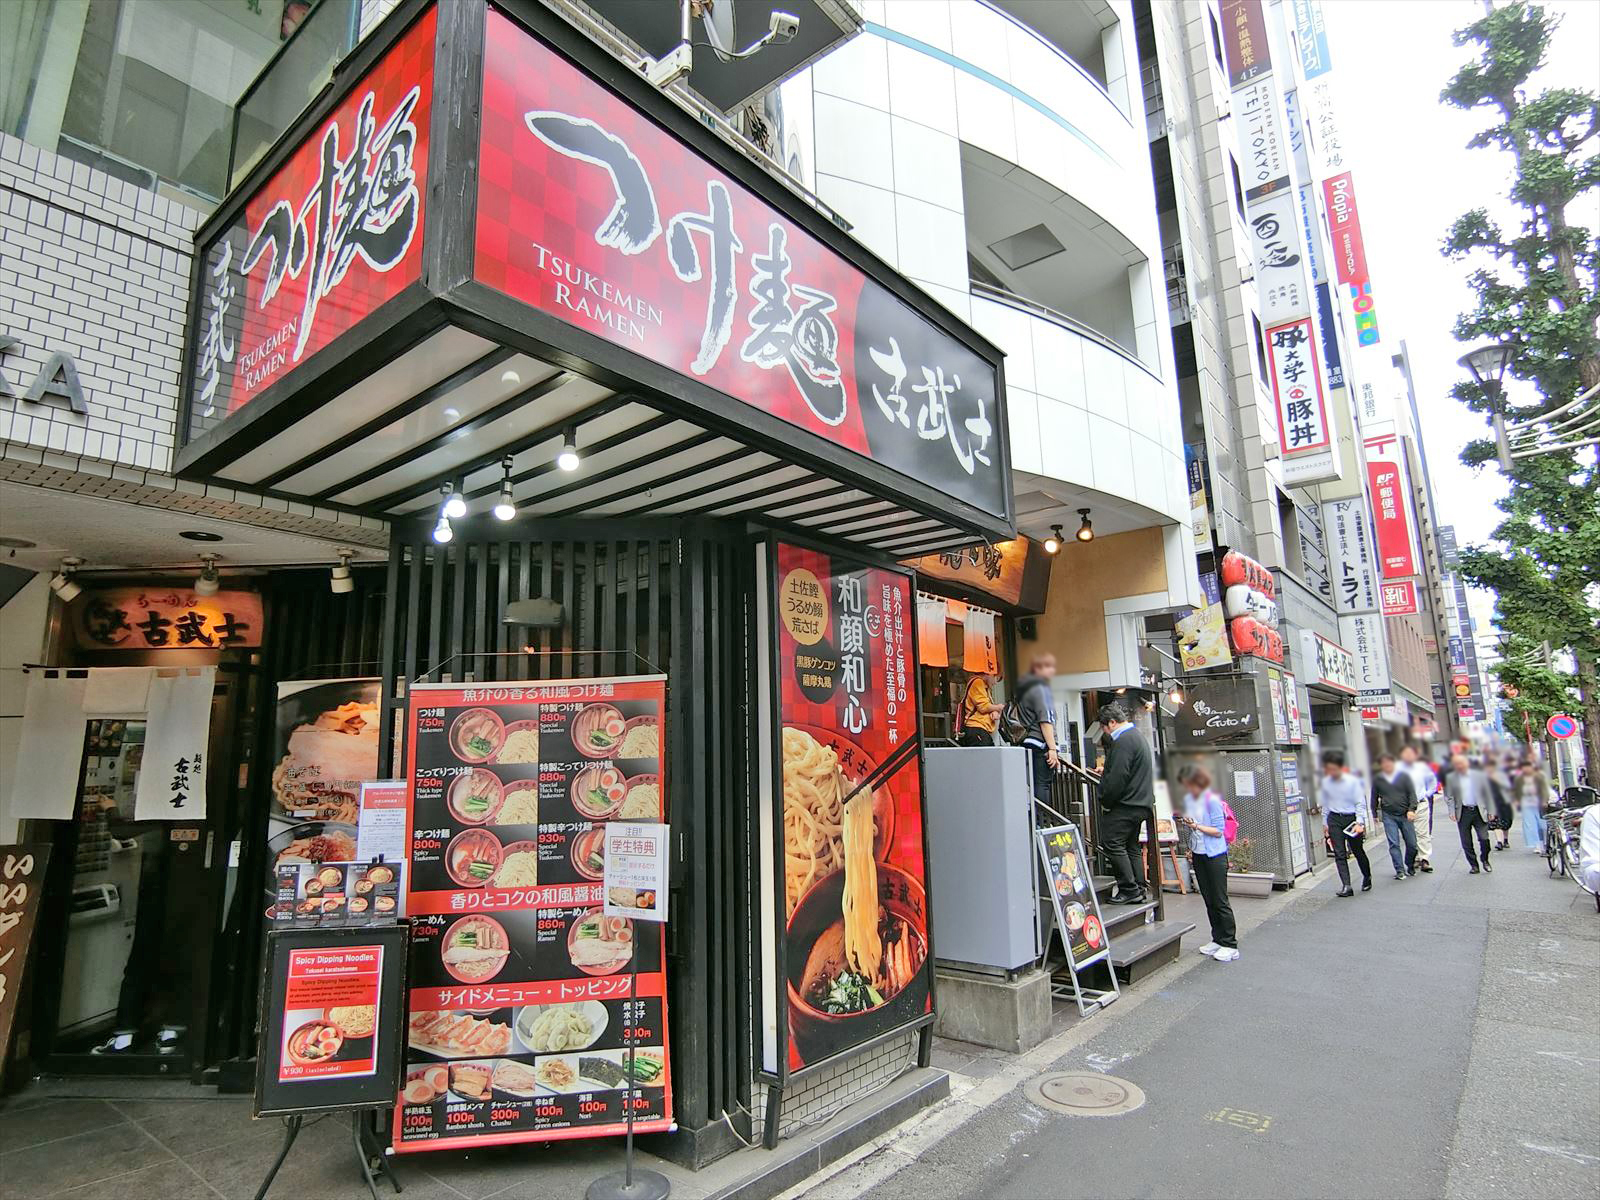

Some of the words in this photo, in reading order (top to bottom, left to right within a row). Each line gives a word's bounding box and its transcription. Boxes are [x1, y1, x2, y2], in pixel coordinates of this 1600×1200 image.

[1240, 66, 1258, 80] 4F
[1261, 86, 1272, 127] MODERN
[1268, 131, 1280, 170] KOREAN
[1250, 126, 1270, 181] TOKYO
[1260, 181, 1277, 193] 3F
[241, 86, 420, 363] つけ麺
[524, 110, 847, 426] つけ麺
[532, 242, 664, 328] TSUKEMEN
[554, 281, 646, 344] RAMEN
[239, 317, 298, 375] TSUKEMEN
[245, 348, 286, 392] RAMEN
[869, 336, 992, 475] 古武士
[1286, 398, 1317, 447] 豚丼
[1380, 487, 1396, 520] 郵便局
[1336, 514, 1348, 556] 司法書士法人
[790, 579, 819, 598] 土佐鰹
[1341, 561, 1358, 610] トライ
[1384, 586, 1406, 606] 靴
[787, 598, 822, 618] うるめ鰯
[136, 611, 250, 646] 古武士
[792, 617, 820, 635] 荒さば
[893, 586, 907, 703] 魚介出汁と豚骨の
[838, 574, 868, 734] 和顔和心
[796, 656, 836, 672] 黒豚ゲンコツ
[882, 584, 898, 744] 旨味を極めた至福の一杯
[463, 684, 614, 701] 魚介の香る和風つけ麺
[419, 708, 445, 718] つけ麺
[540, 703, 584, 712] 特製つけ麺
[419, 718, 444, 728] 750円
[540, 713, 566, 722] 880円
[416, 767, 473, 778] こってりつけ麺
[540, 760, 614, 772] 特製こってりつけ麺
[170, 757, 190, 808] 古武士
[416, 778, 443, 787] 750円
[540, 772, 566, 782] 880円
[414, 828, 450, 840] 辛つけ麺
[539, 822, 592, 834] 特製辛つけ麺
[414, 840, 441, 849] 800円
[539, 834, 566, 842] 930円
[612, 840, 654, 854] 学生特典
[450, 886, 604, 910] 香りとコクの和風醤油
[538, 906, 592, 919] 特製らーめん
[412, 915, 446, 926] らーめん
[538, 920, 566, 928] 860円
[412, 926, 439, 936] 730円
[296, 956, 315, 965] Spicy
[318, 955, 344, 964] Dipping
[346, 954, 375, 962] Noodles.
[438, 976, 632, 1006] サイドメニュー・トッピング
[578, 1094, 592, 1102] 海苔
[622, 1090, 642, 1098] 江菜
[446, 1102, 485, 1112] 自家製メンマ
[535, 1097, 555, 1106] 辛ねぎ
[580, 1102, 607, 1112] 100円
[404, 1106, 432, 1115] 半熟味玉
[491, 1109, 520, 1120] 300円
[536, 1106, 563, 1116] 100円
[405, 1116, 433, 1126] 100円
[448, 1112, 475, 1123] 100円
